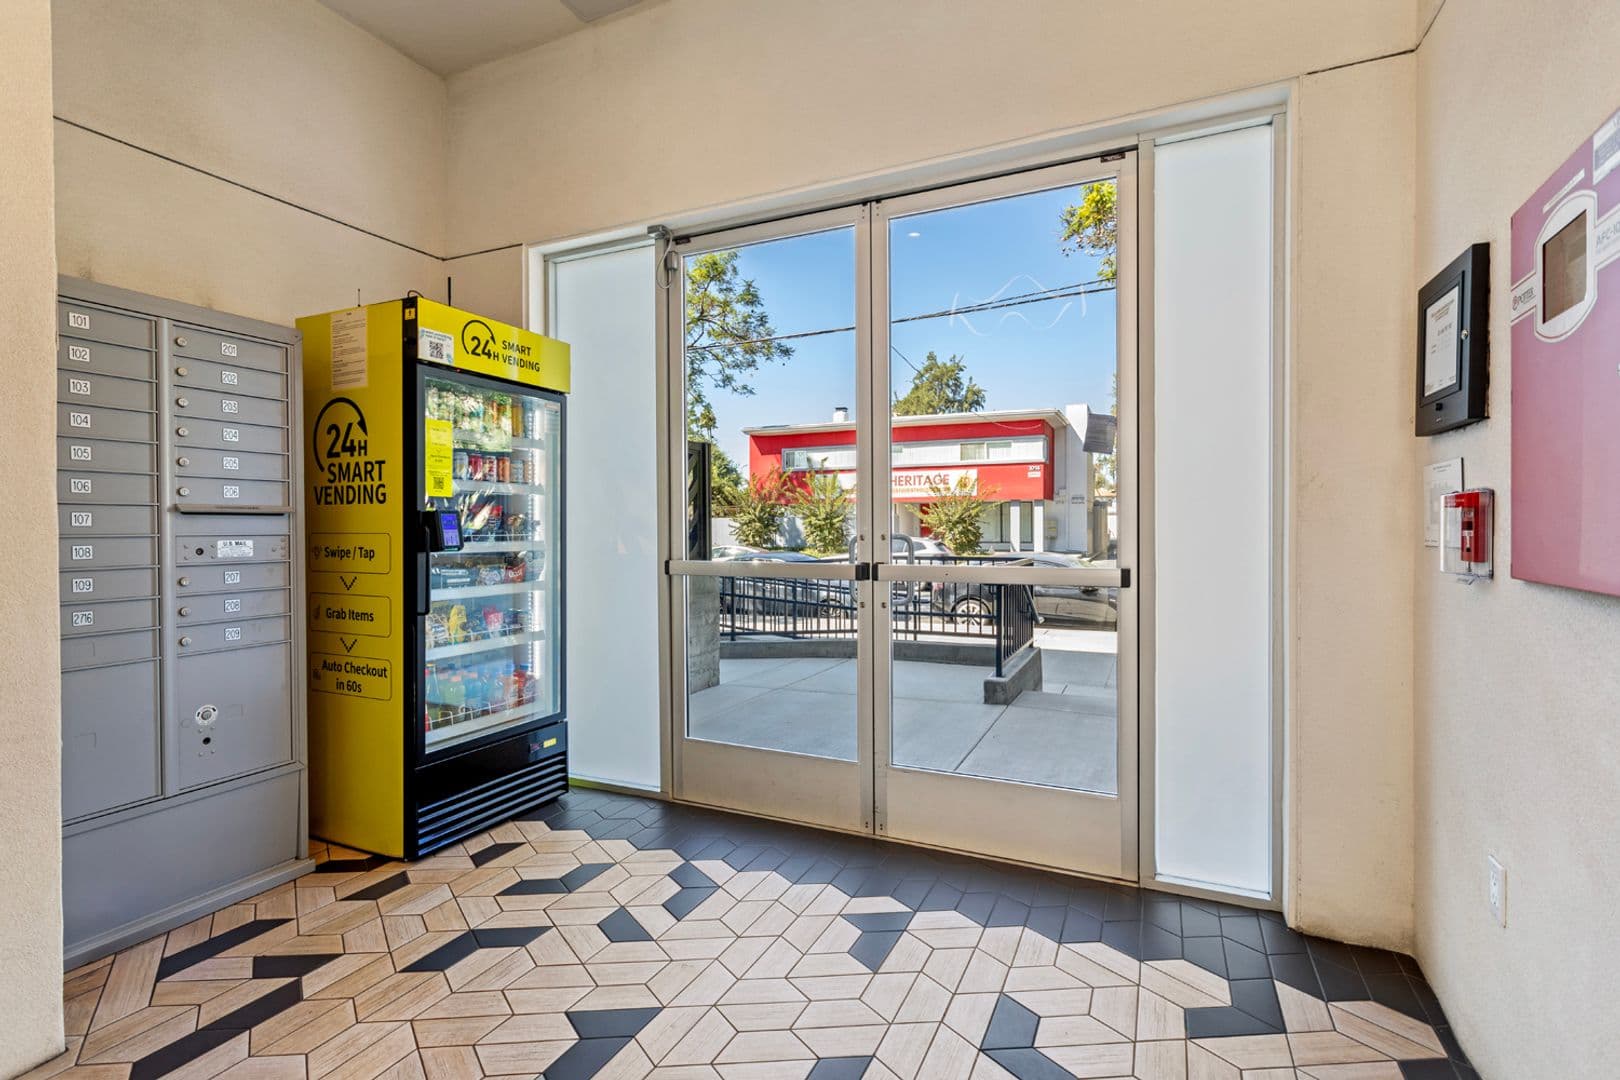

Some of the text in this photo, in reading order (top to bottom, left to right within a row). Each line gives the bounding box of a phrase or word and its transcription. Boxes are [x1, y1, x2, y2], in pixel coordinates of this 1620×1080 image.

[72, 315, 87, 327] 101
[71, 348, 88, 360] 102
[223, 344, 236, 355] 201
[502, 340, 531, 357] SMART
[501, 353, 541, 372] VENDING
[222, 372, 237, 384] 202
[71, 381, 88, 393] 103
[223, 401, 237, 412] 203
[72, 414, 88, 425] 104
[224, 429, 238, 440] 204
[73, 448, 90, 459] 105
[224, 458, 238, 469] 205
[327, 460, 386, 484] SMART
[73, 480, 90, 491] 106
[892, 474, 950, 486] HERITAGE
[225, 487, 238, 497] 206
[313, 483, 387, 506] VENDING
[74, 514, 90, 525] 107
[74, 547, 91, 558] 108
[324, 546, 351, 560] Swipe
[358, 546, 375, 561] Tap
[225, 572, 239, 582] 207
[74, 580, 91, 591] 109
[225, 600, 240, 611] 208
[74, 613, 92, 625] 2716
[325, 607, 374, 622] Grab Items
[322, 659, 388, 678] Auto Checkout
[336, 678, 362, 693] in 60s
